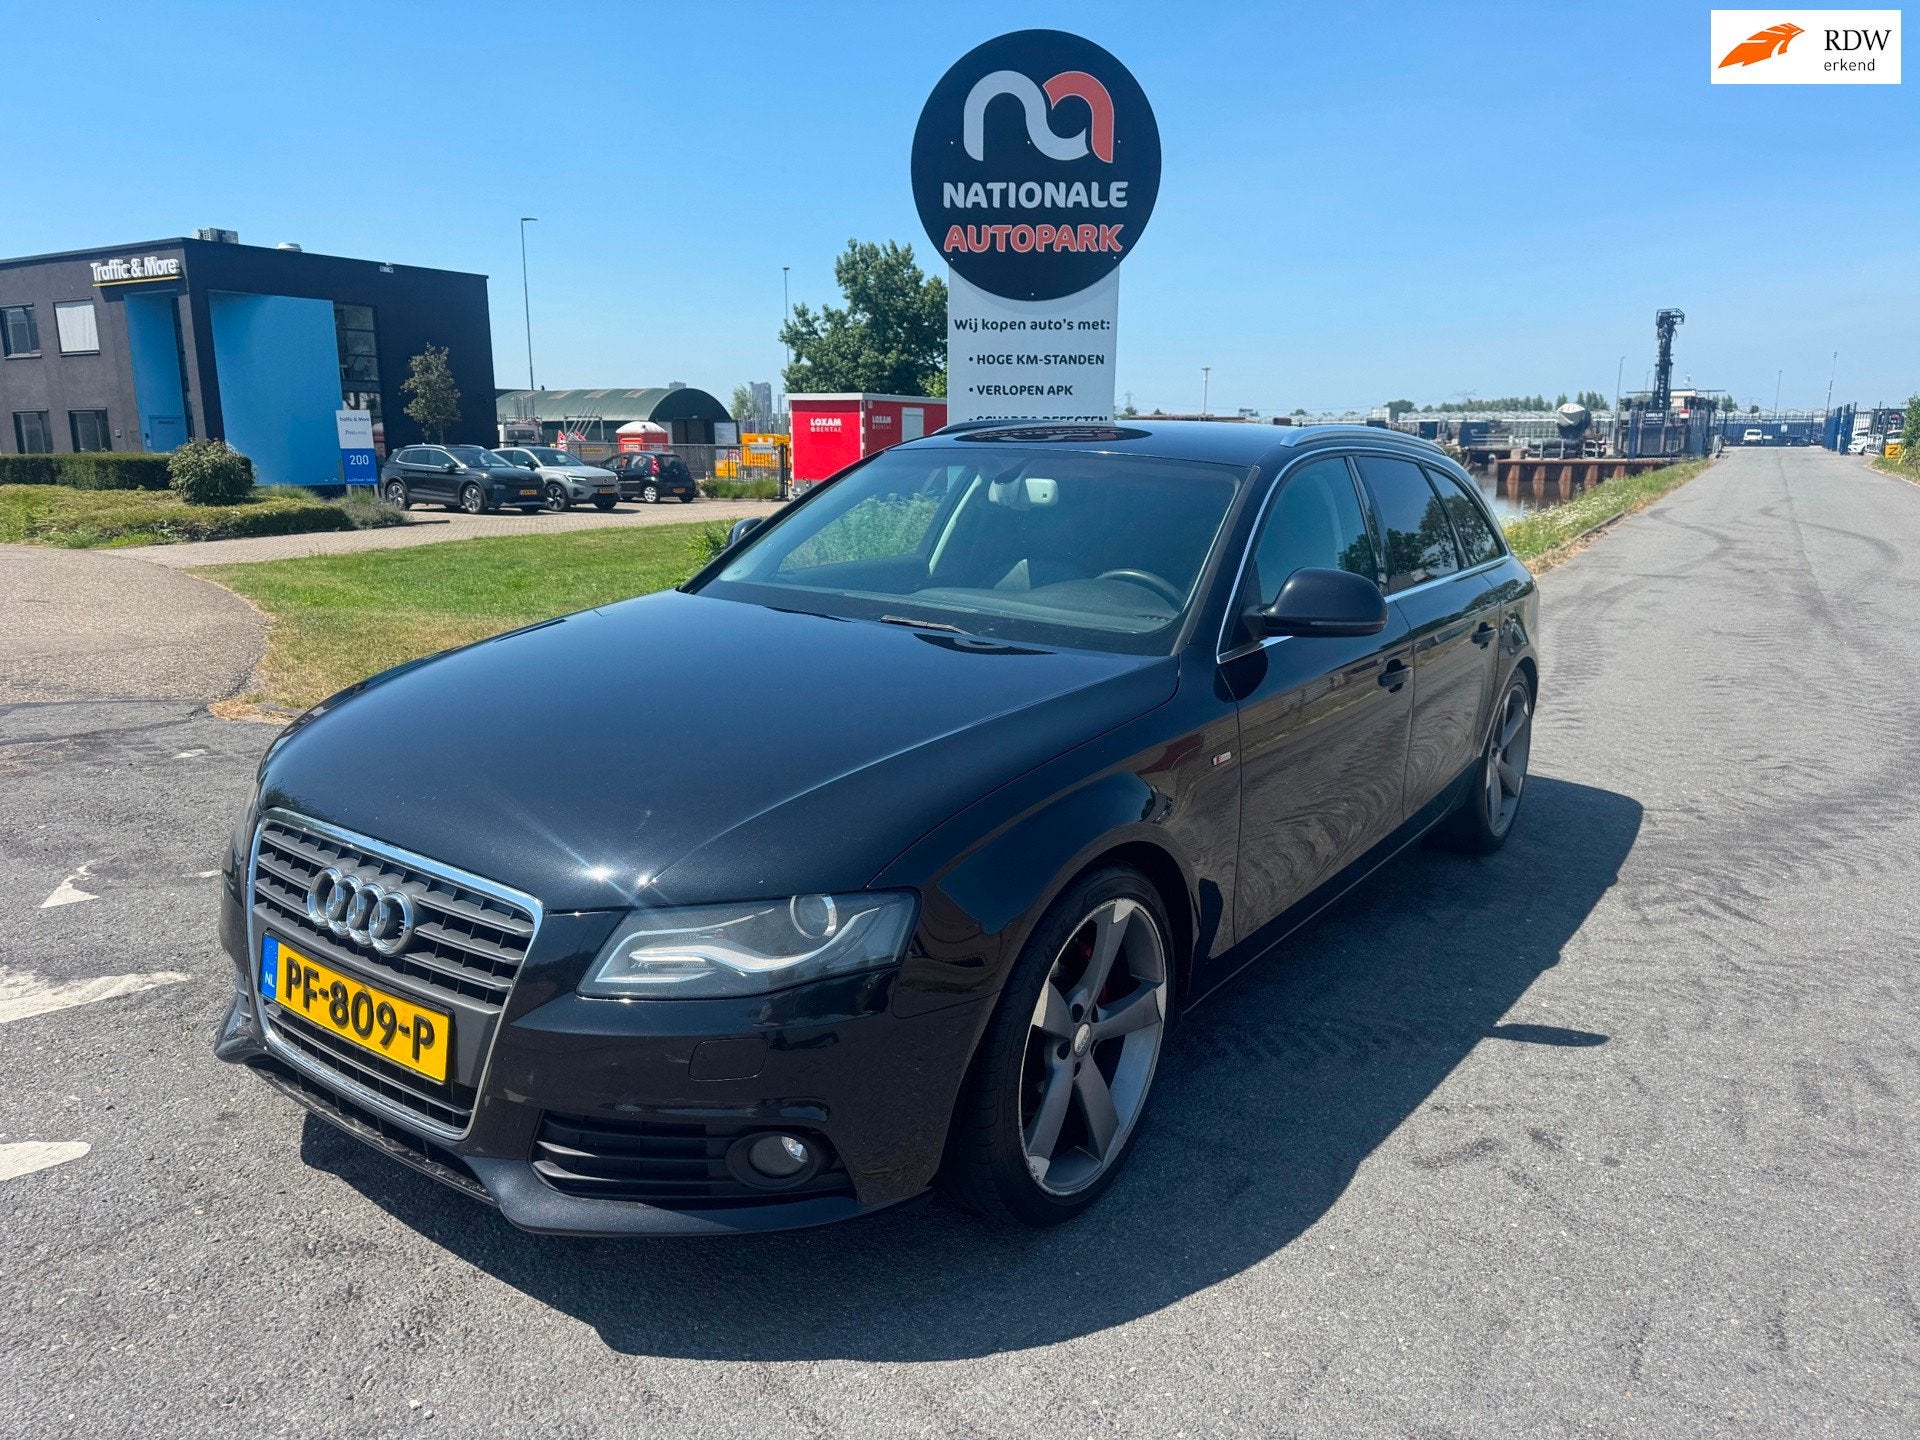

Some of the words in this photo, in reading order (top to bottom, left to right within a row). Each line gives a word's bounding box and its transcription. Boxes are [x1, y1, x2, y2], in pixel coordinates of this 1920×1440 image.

[943, 181, 1128, 208] NATIONALE
[944, 224, 1124, 252] AUTOPARK
[90, 259, 131, 281] Traffic
[130, 258, 144, 277] &
[144, 256, 179, 276] More
[954, 318, 978, 333] Wij
[981, 318, 1026, 333] kopen
[1030, 318, 1074, 331] auto's
[1077, 319, 1111, 331] met:
[977, 354, 1013, 365] HOGE
[1016, 354, 1105, 365] KM-STANDEN
[977, 385, 1044, 396] VERLOPEN
[1047, 385, 1074, 396] APK
[810, 418, 841, 426] LOXAM
[350, 454, 368, 465] 200
[264, 971, 276, 989] NL
[285, 956, 435, 1061] PF-809-P
